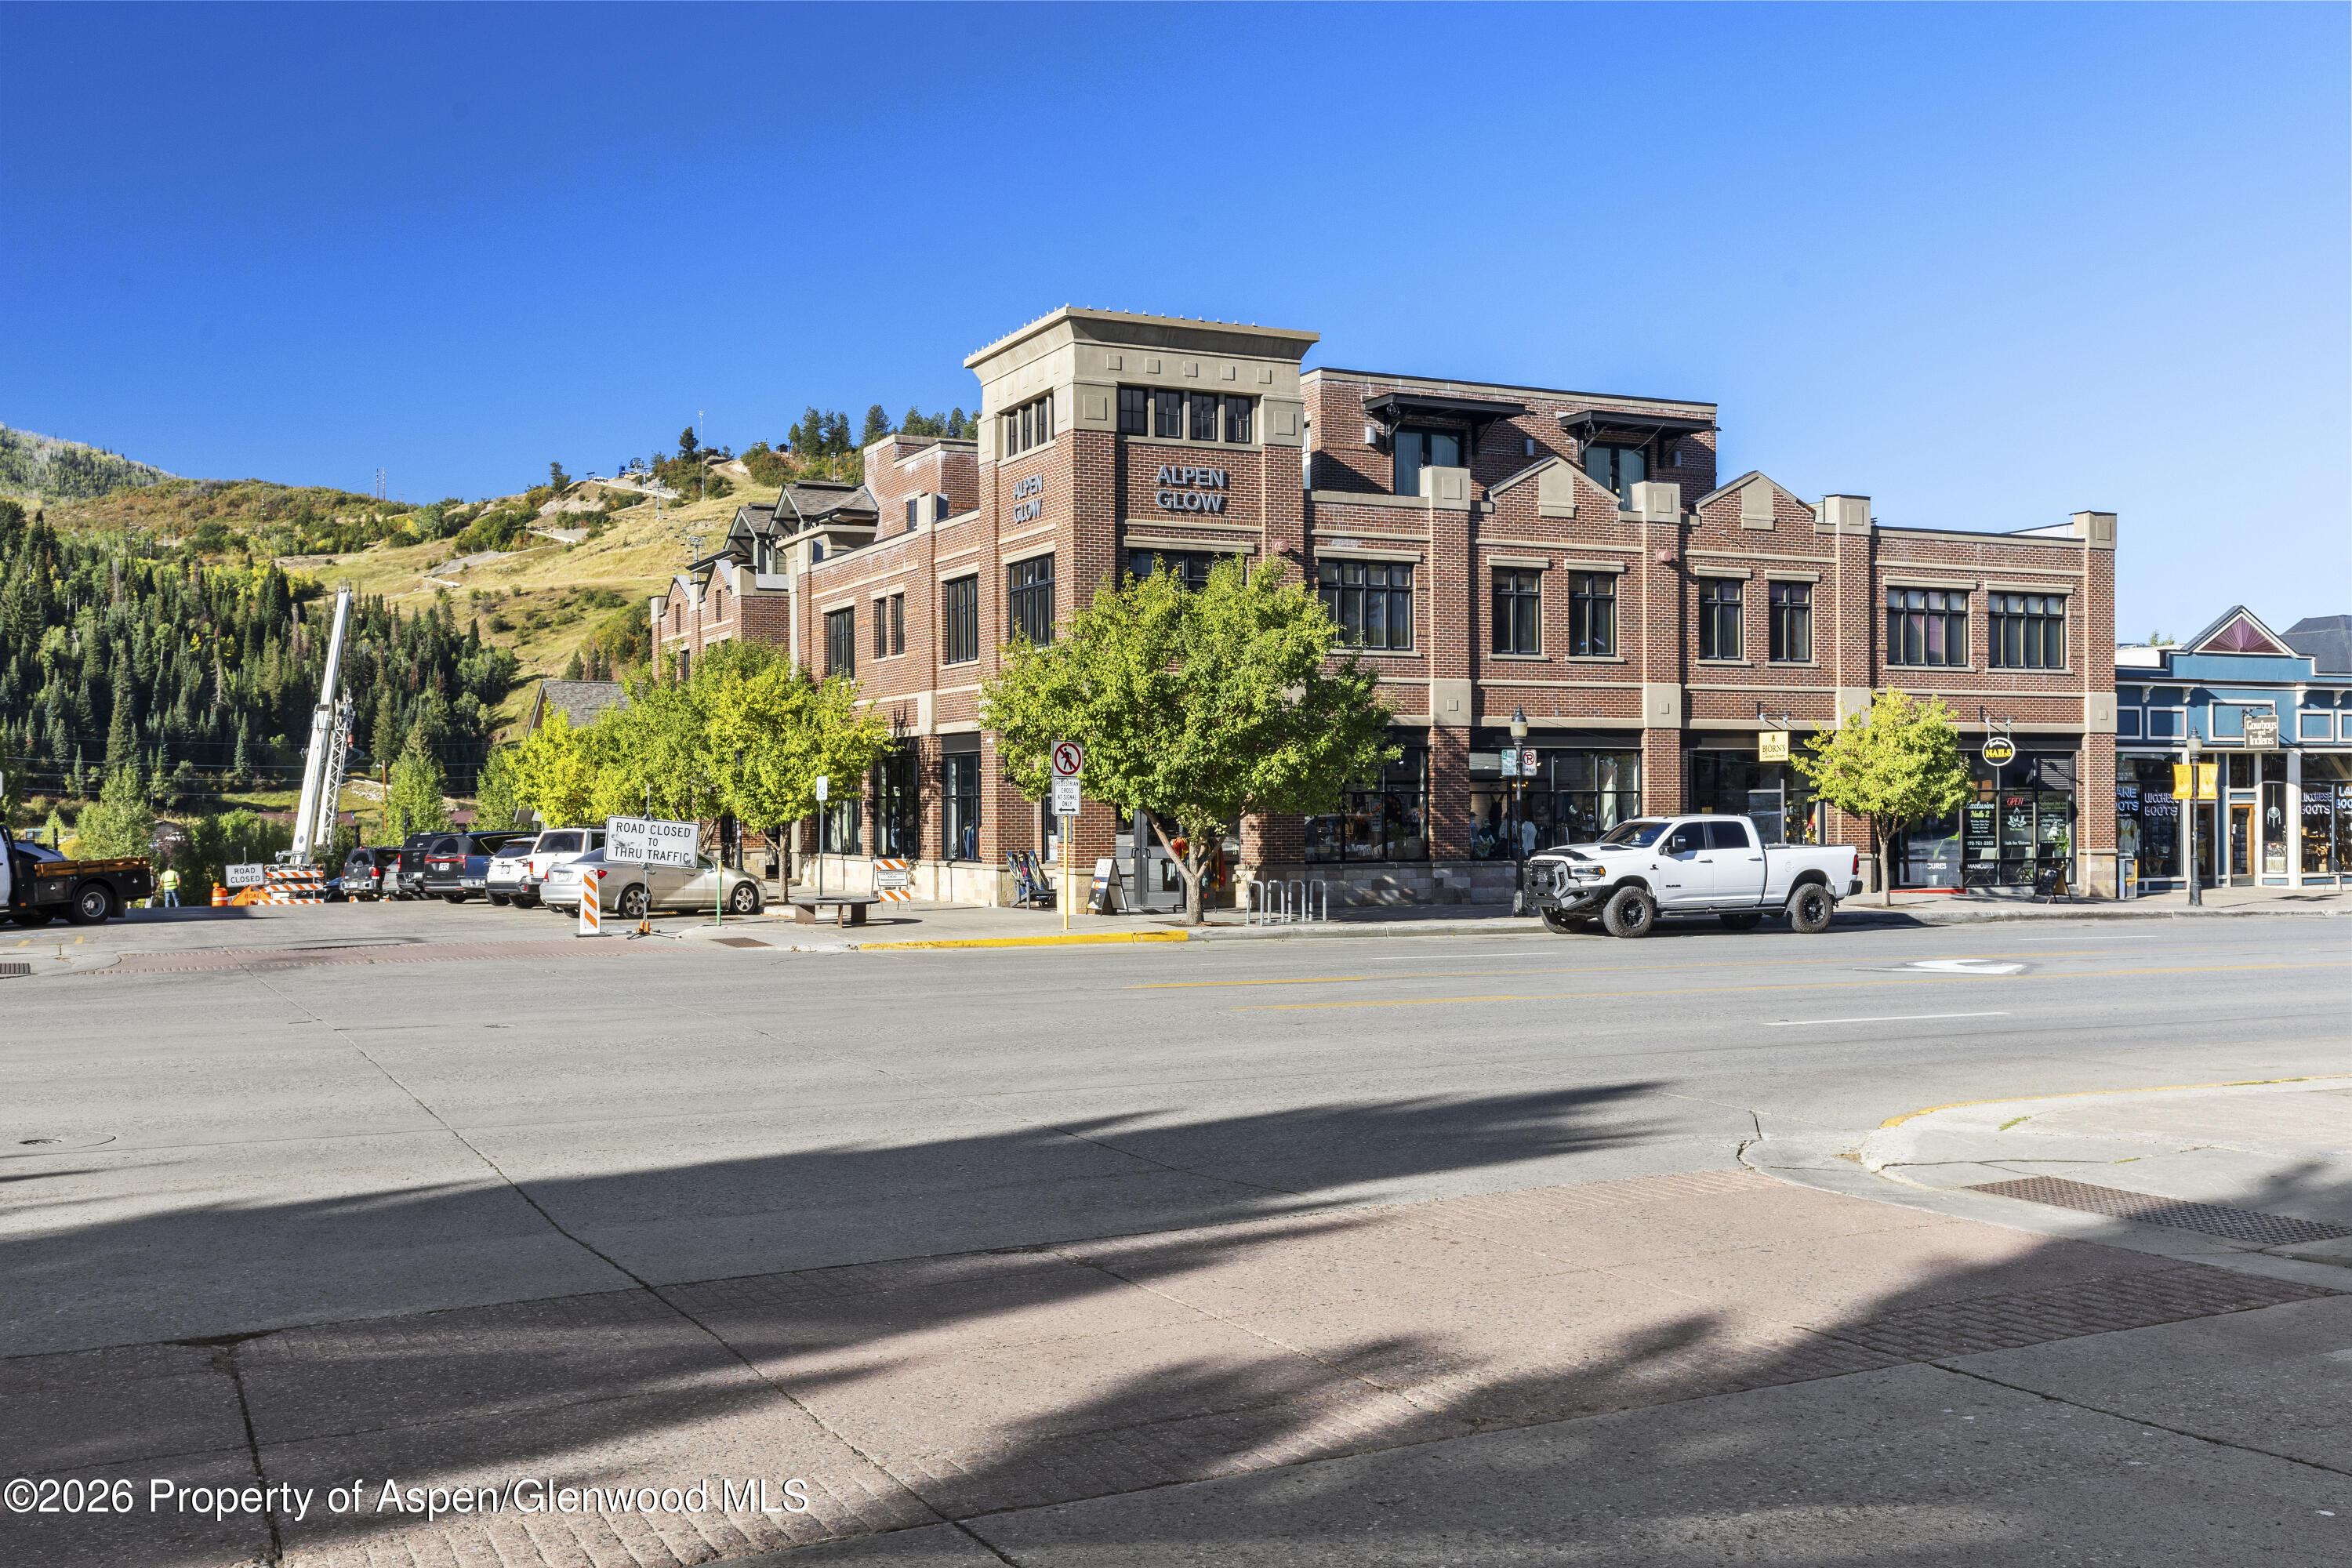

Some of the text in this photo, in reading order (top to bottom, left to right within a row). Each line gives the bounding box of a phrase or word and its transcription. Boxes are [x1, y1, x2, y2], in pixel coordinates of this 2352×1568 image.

[1155, 465, 1224, 487] ALPEN
[1014, 474, 1043, 499] ALPEN
[1156, 490, 1222, 512] GLOW
[1014, 498, 1042, 524] GLOW
[2246, 720, 2277, 731] Cowboys
[2249, 735, 2274, 746] Indians
[1985, 748, 2012, 758] NAILS
[2115, 786, 2137, 798] ANE
[1965, 800, 1995, 810] Exclusive
[2007, 797, 2024, 807] OPEN
[2144, 806, 2178, 816] BOOTS
[616, 822, 691, 838] ROAD CLOSED
[648, 837, 659, 847] TO
[614, 847, 690, 863] THRU TRAFFIC
[230, 875, 260, 884] CLOSED
